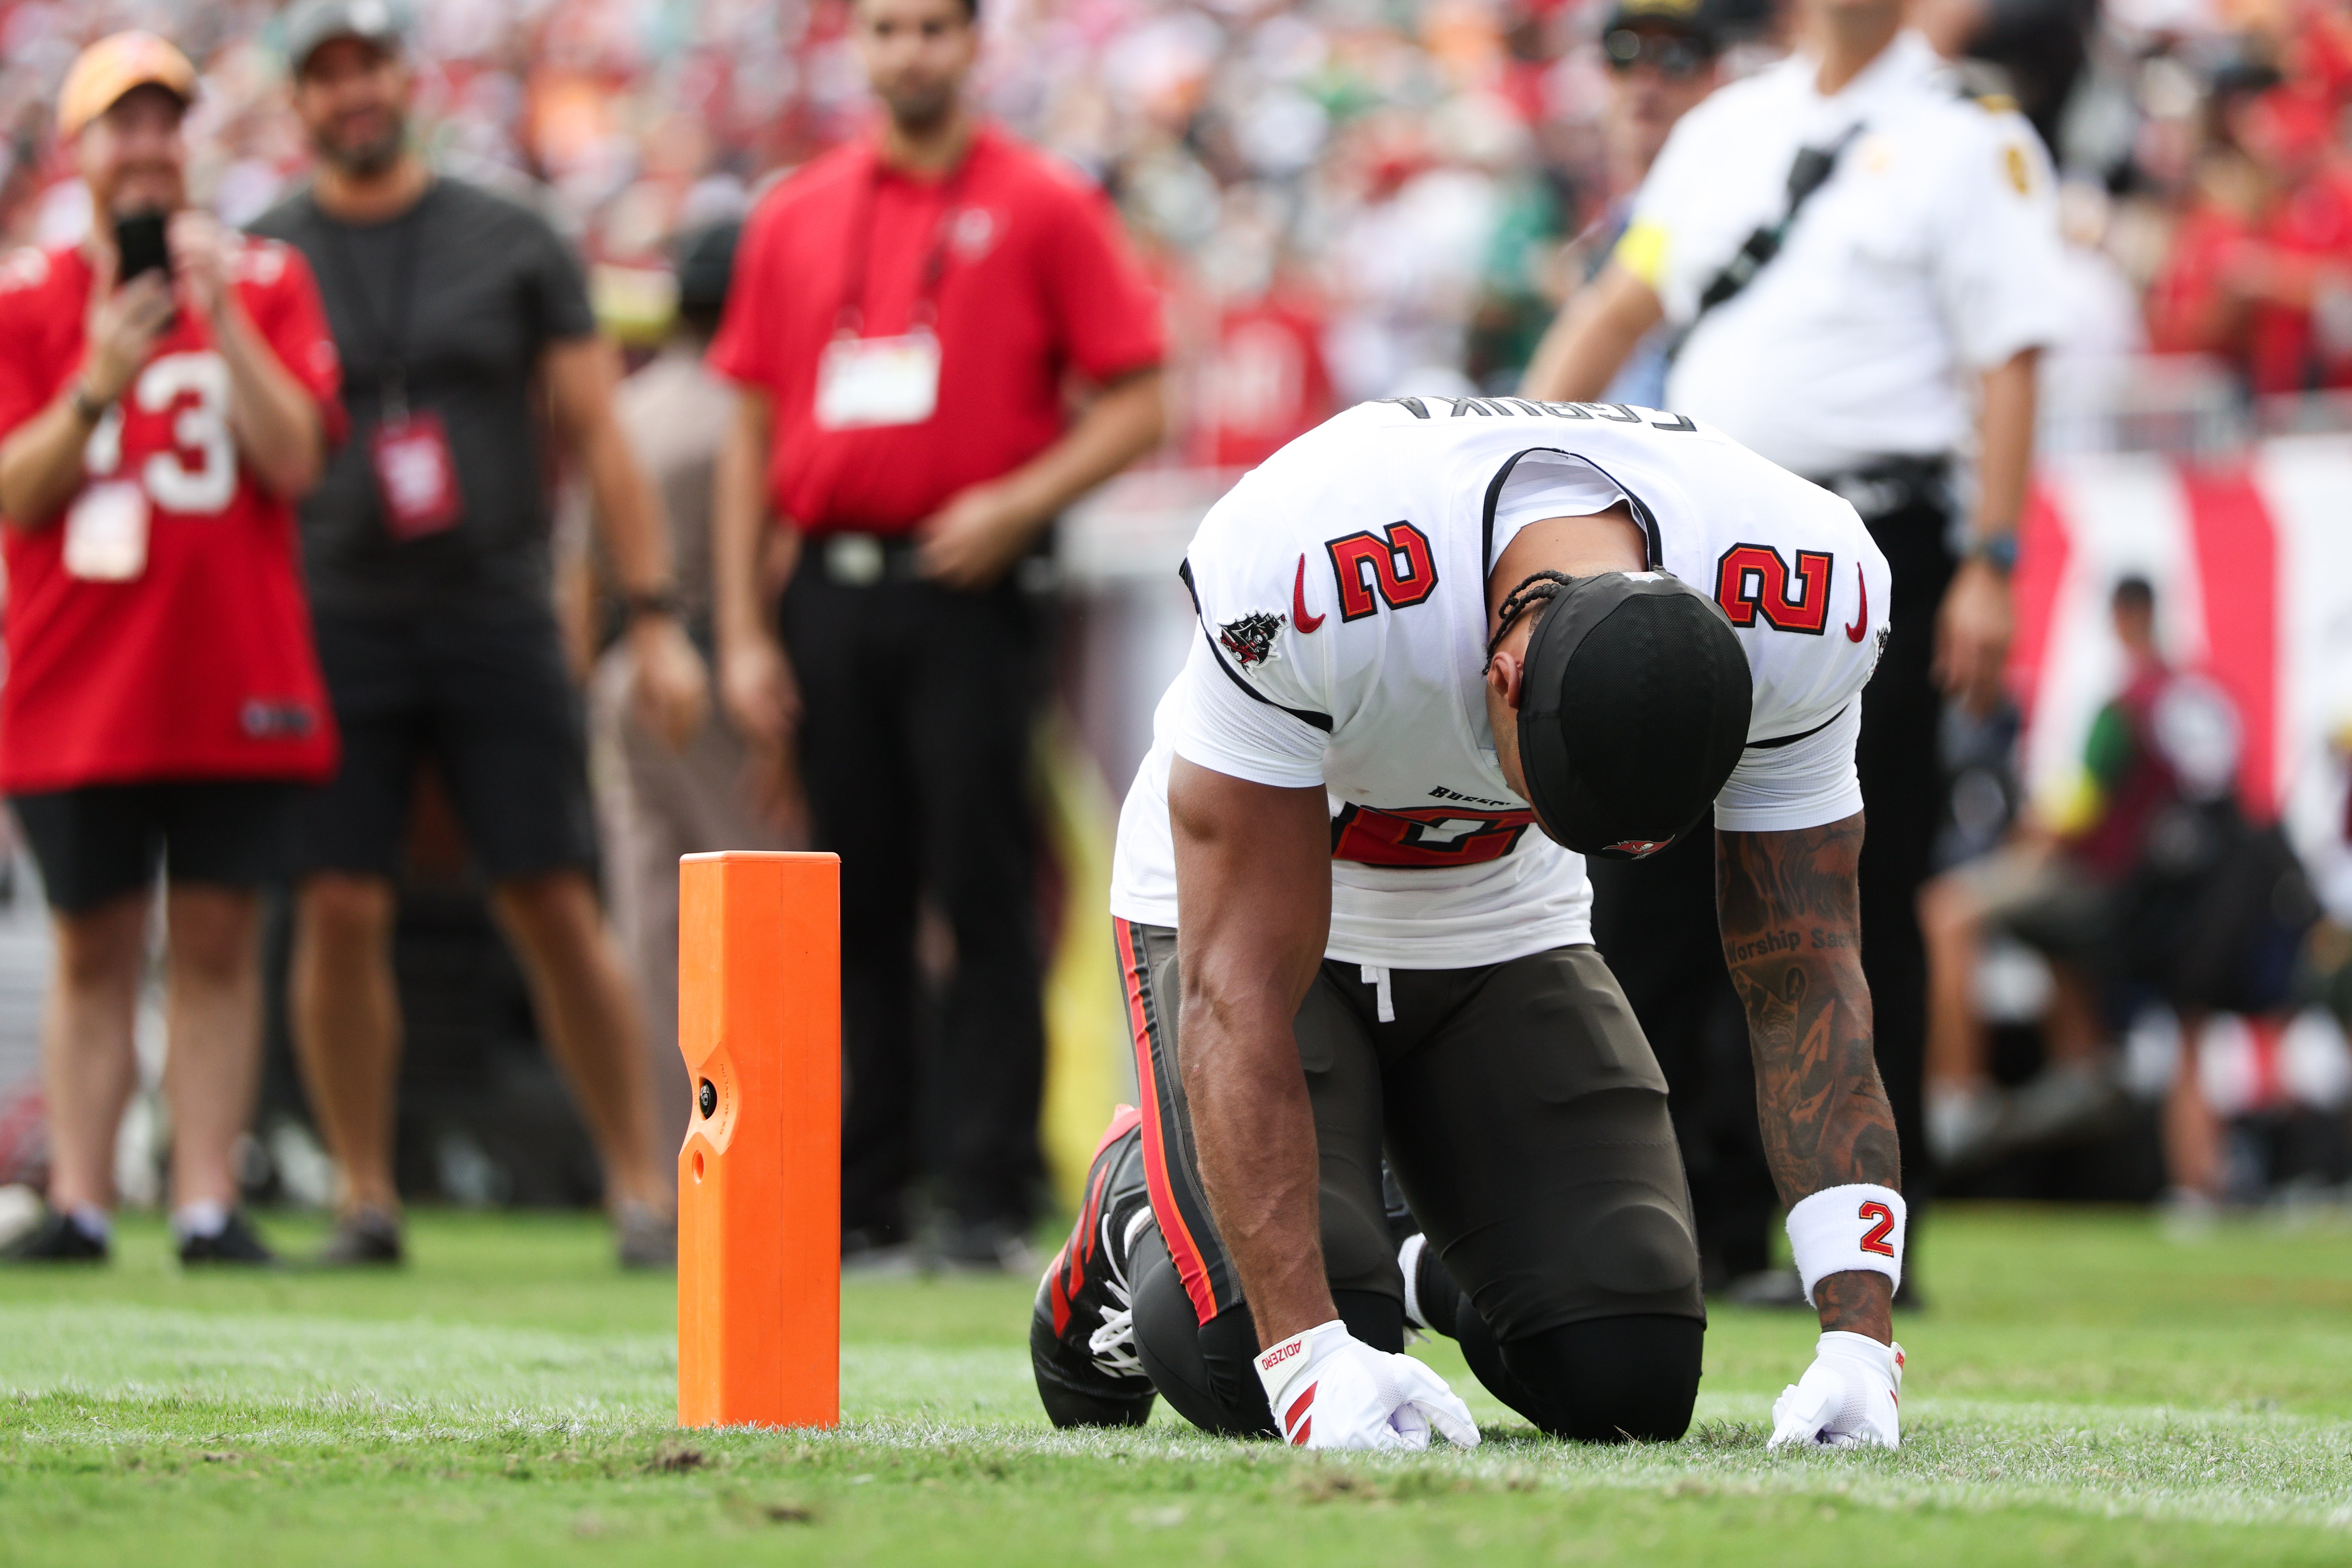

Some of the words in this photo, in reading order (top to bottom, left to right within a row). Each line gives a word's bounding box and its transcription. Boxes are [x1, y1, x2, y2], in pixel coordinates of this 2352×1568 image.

[1325, 520, 1438, 623] 2
[1716, 543, 1833, 635] 2
[1726, 930, 1801, 964] Worship
[1859, 1201, 1894, 1257] 2
[1262, 1339, 1301, 1370] ADIZERO
